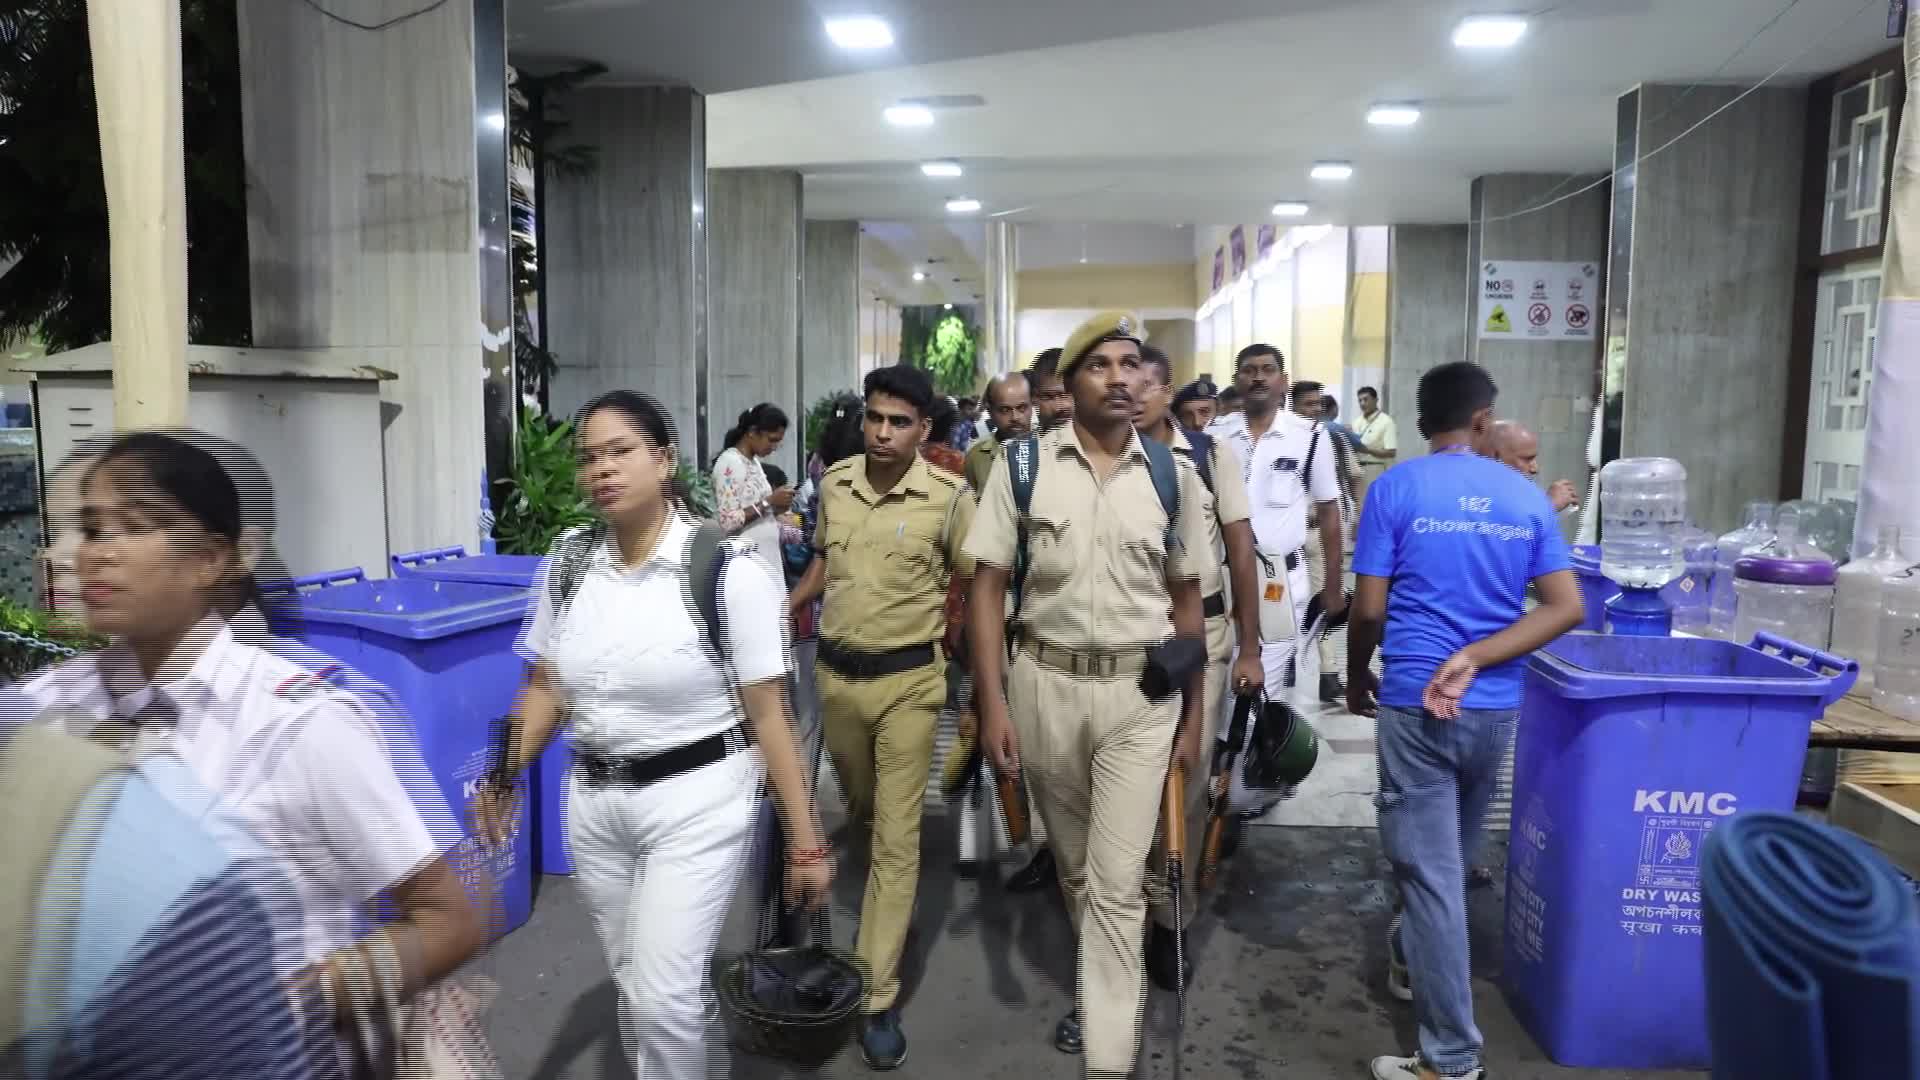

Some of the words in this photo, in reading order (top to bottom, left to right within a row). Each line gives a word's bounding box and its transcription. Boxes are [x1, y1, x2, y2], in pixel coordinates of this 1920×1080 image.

[1486, 280, 1500, 291] NO
[1457, 495, 1491, 513] 162
[1634, 789, 1738, 816] KMC
[1623, 887, 1659, 901] DRY
[1664, 890, 1702, 903] WAS
[1672, 925, 1703, 936] कच
